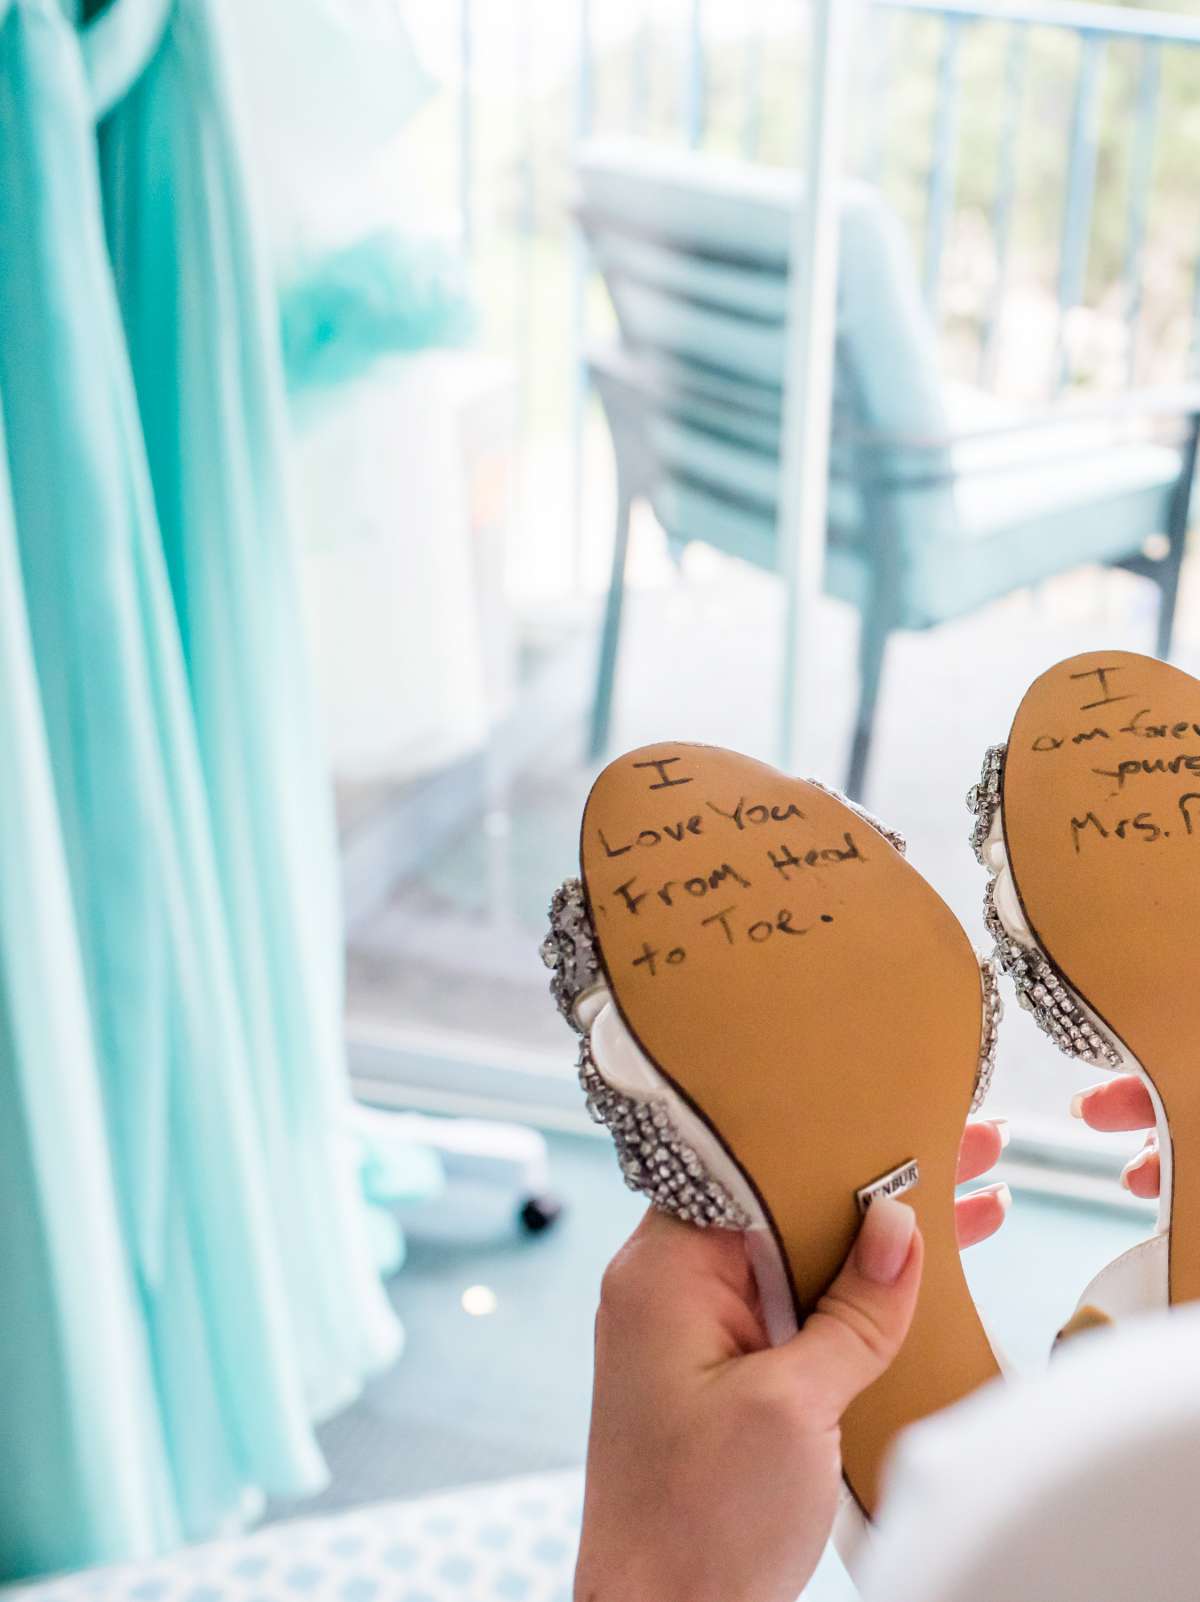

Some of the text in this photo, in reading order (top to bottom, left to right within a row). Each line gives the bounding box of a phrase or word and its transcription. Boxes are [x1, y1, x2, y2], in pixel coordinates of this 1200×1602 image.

[1070, 667, 1136, 710] I
[633, 756, 693, 790] I
[598, 797, 805, 857] Love You
[1070, 811, 1170, 854] Mrs.
[613, 832, 868, 915] From Head
[632, 942, 686, 976] to
